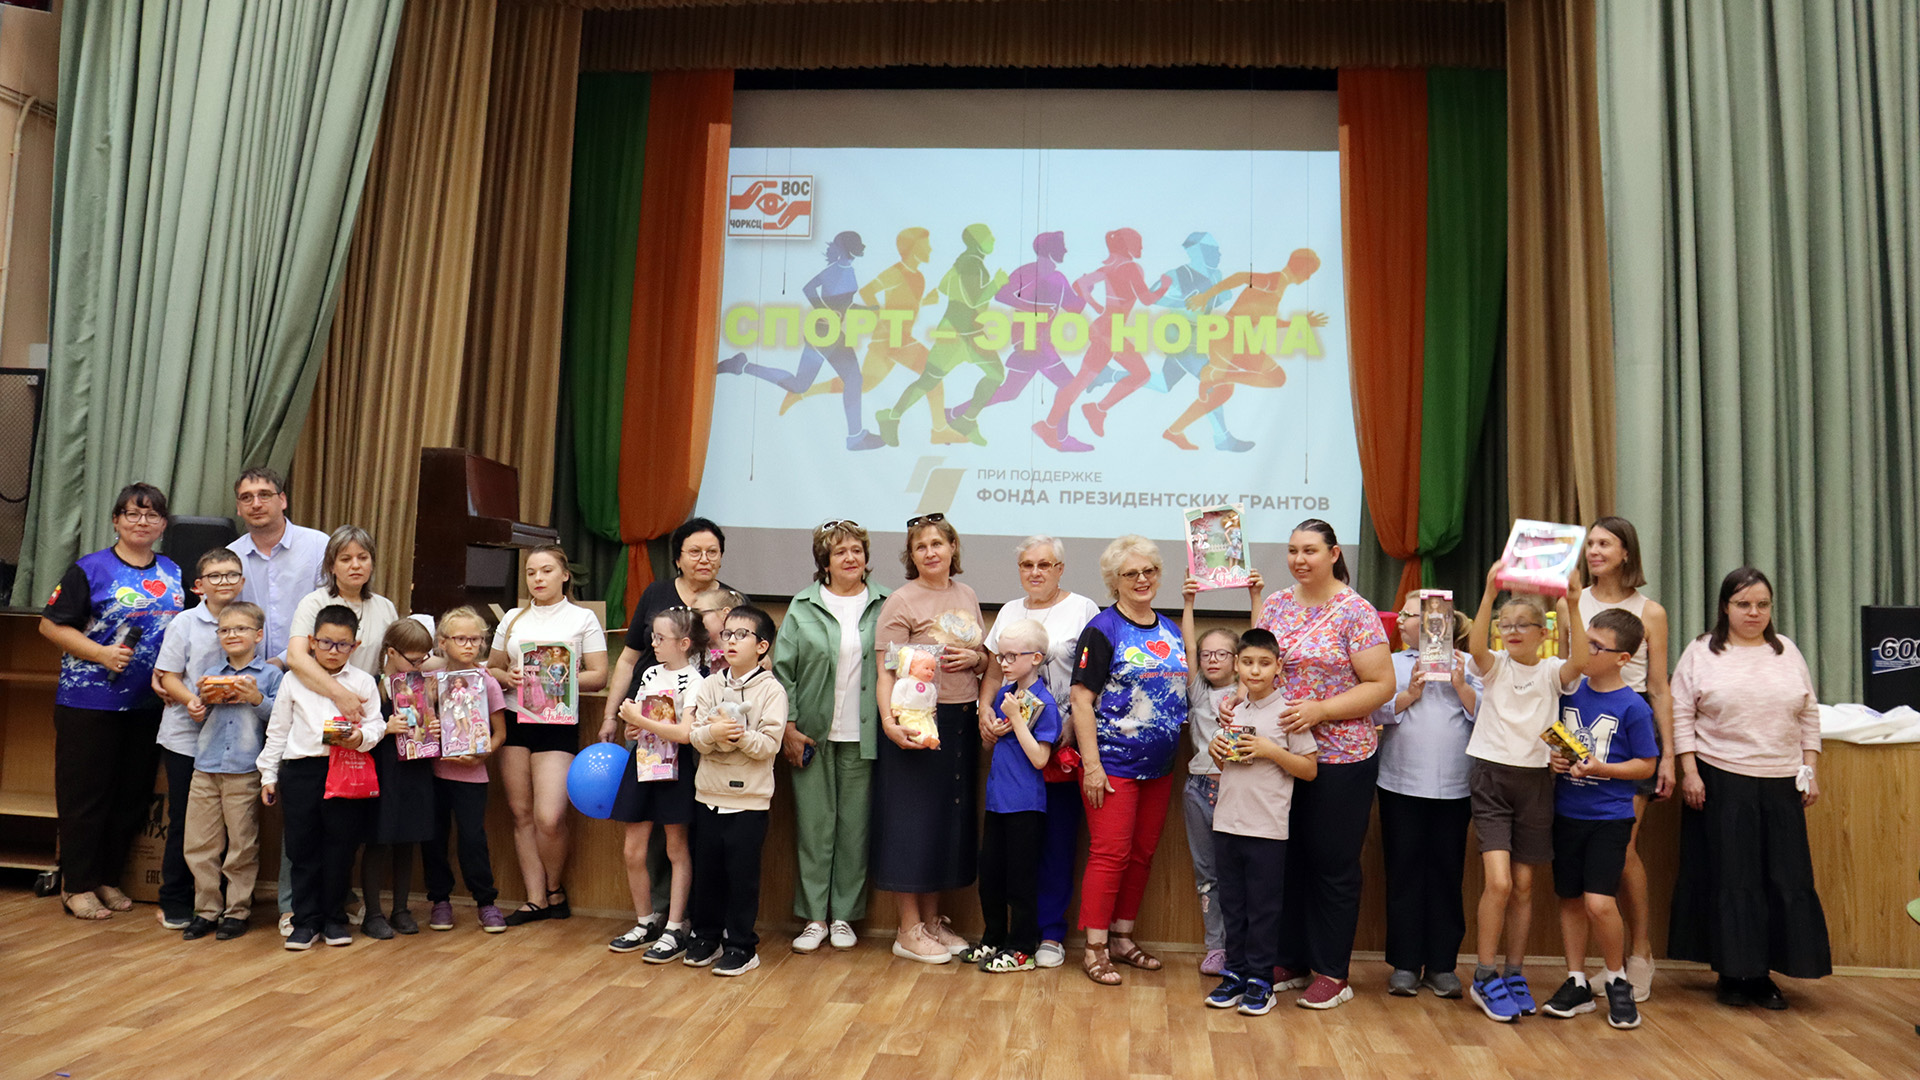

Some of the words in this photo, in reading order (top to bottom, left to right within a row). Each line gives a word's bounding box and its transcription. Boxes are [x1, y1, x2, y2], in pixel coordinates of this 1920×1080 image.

[781, 181, 810, 196] ВОС
[730, 219, 762, 230] ЧОРКСЦ
[725, 306, 914, 347] СПОРТ
[973, 311, 1089, 351] ЭТО
[1110, 313, 1321, 356] НОРМА
[977, 469, 1006, 480] ПРИ
[1010, 470, 1103, 483] ПОДДЕРЖКЕ
[976, 488, 1050, 506] ФОНДА
[1059, 490, 1229, 508] ПРЕЗИДЕНТСКИХ
[1239, 494, 1330, 511] ГРАНТОВ
